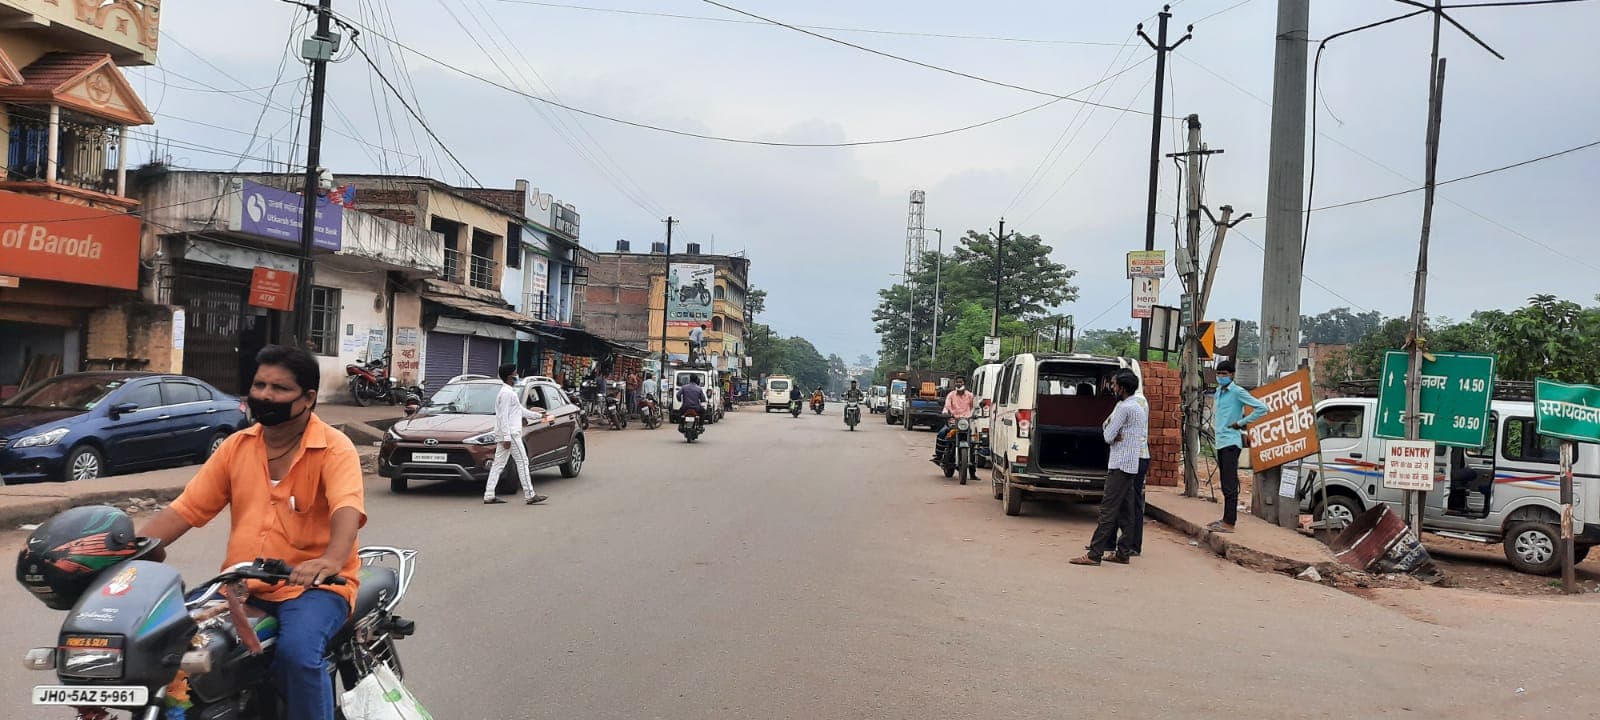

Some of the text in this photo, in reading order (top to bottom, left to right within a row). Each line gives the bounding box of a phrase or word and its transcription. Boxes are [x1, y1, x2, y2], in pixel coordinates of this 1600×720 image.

[2, 223, 103, 259] of Baroda
[1459, 377, 1485, 393] 14.50
[1249, 403, 1314, 449] अटल चौक
[1453, 415, 1480, 430] 30.50
[1260, 437, 1307, 463] सरायकेला
[1391, 446, 1430, 458] NO ENTRY
